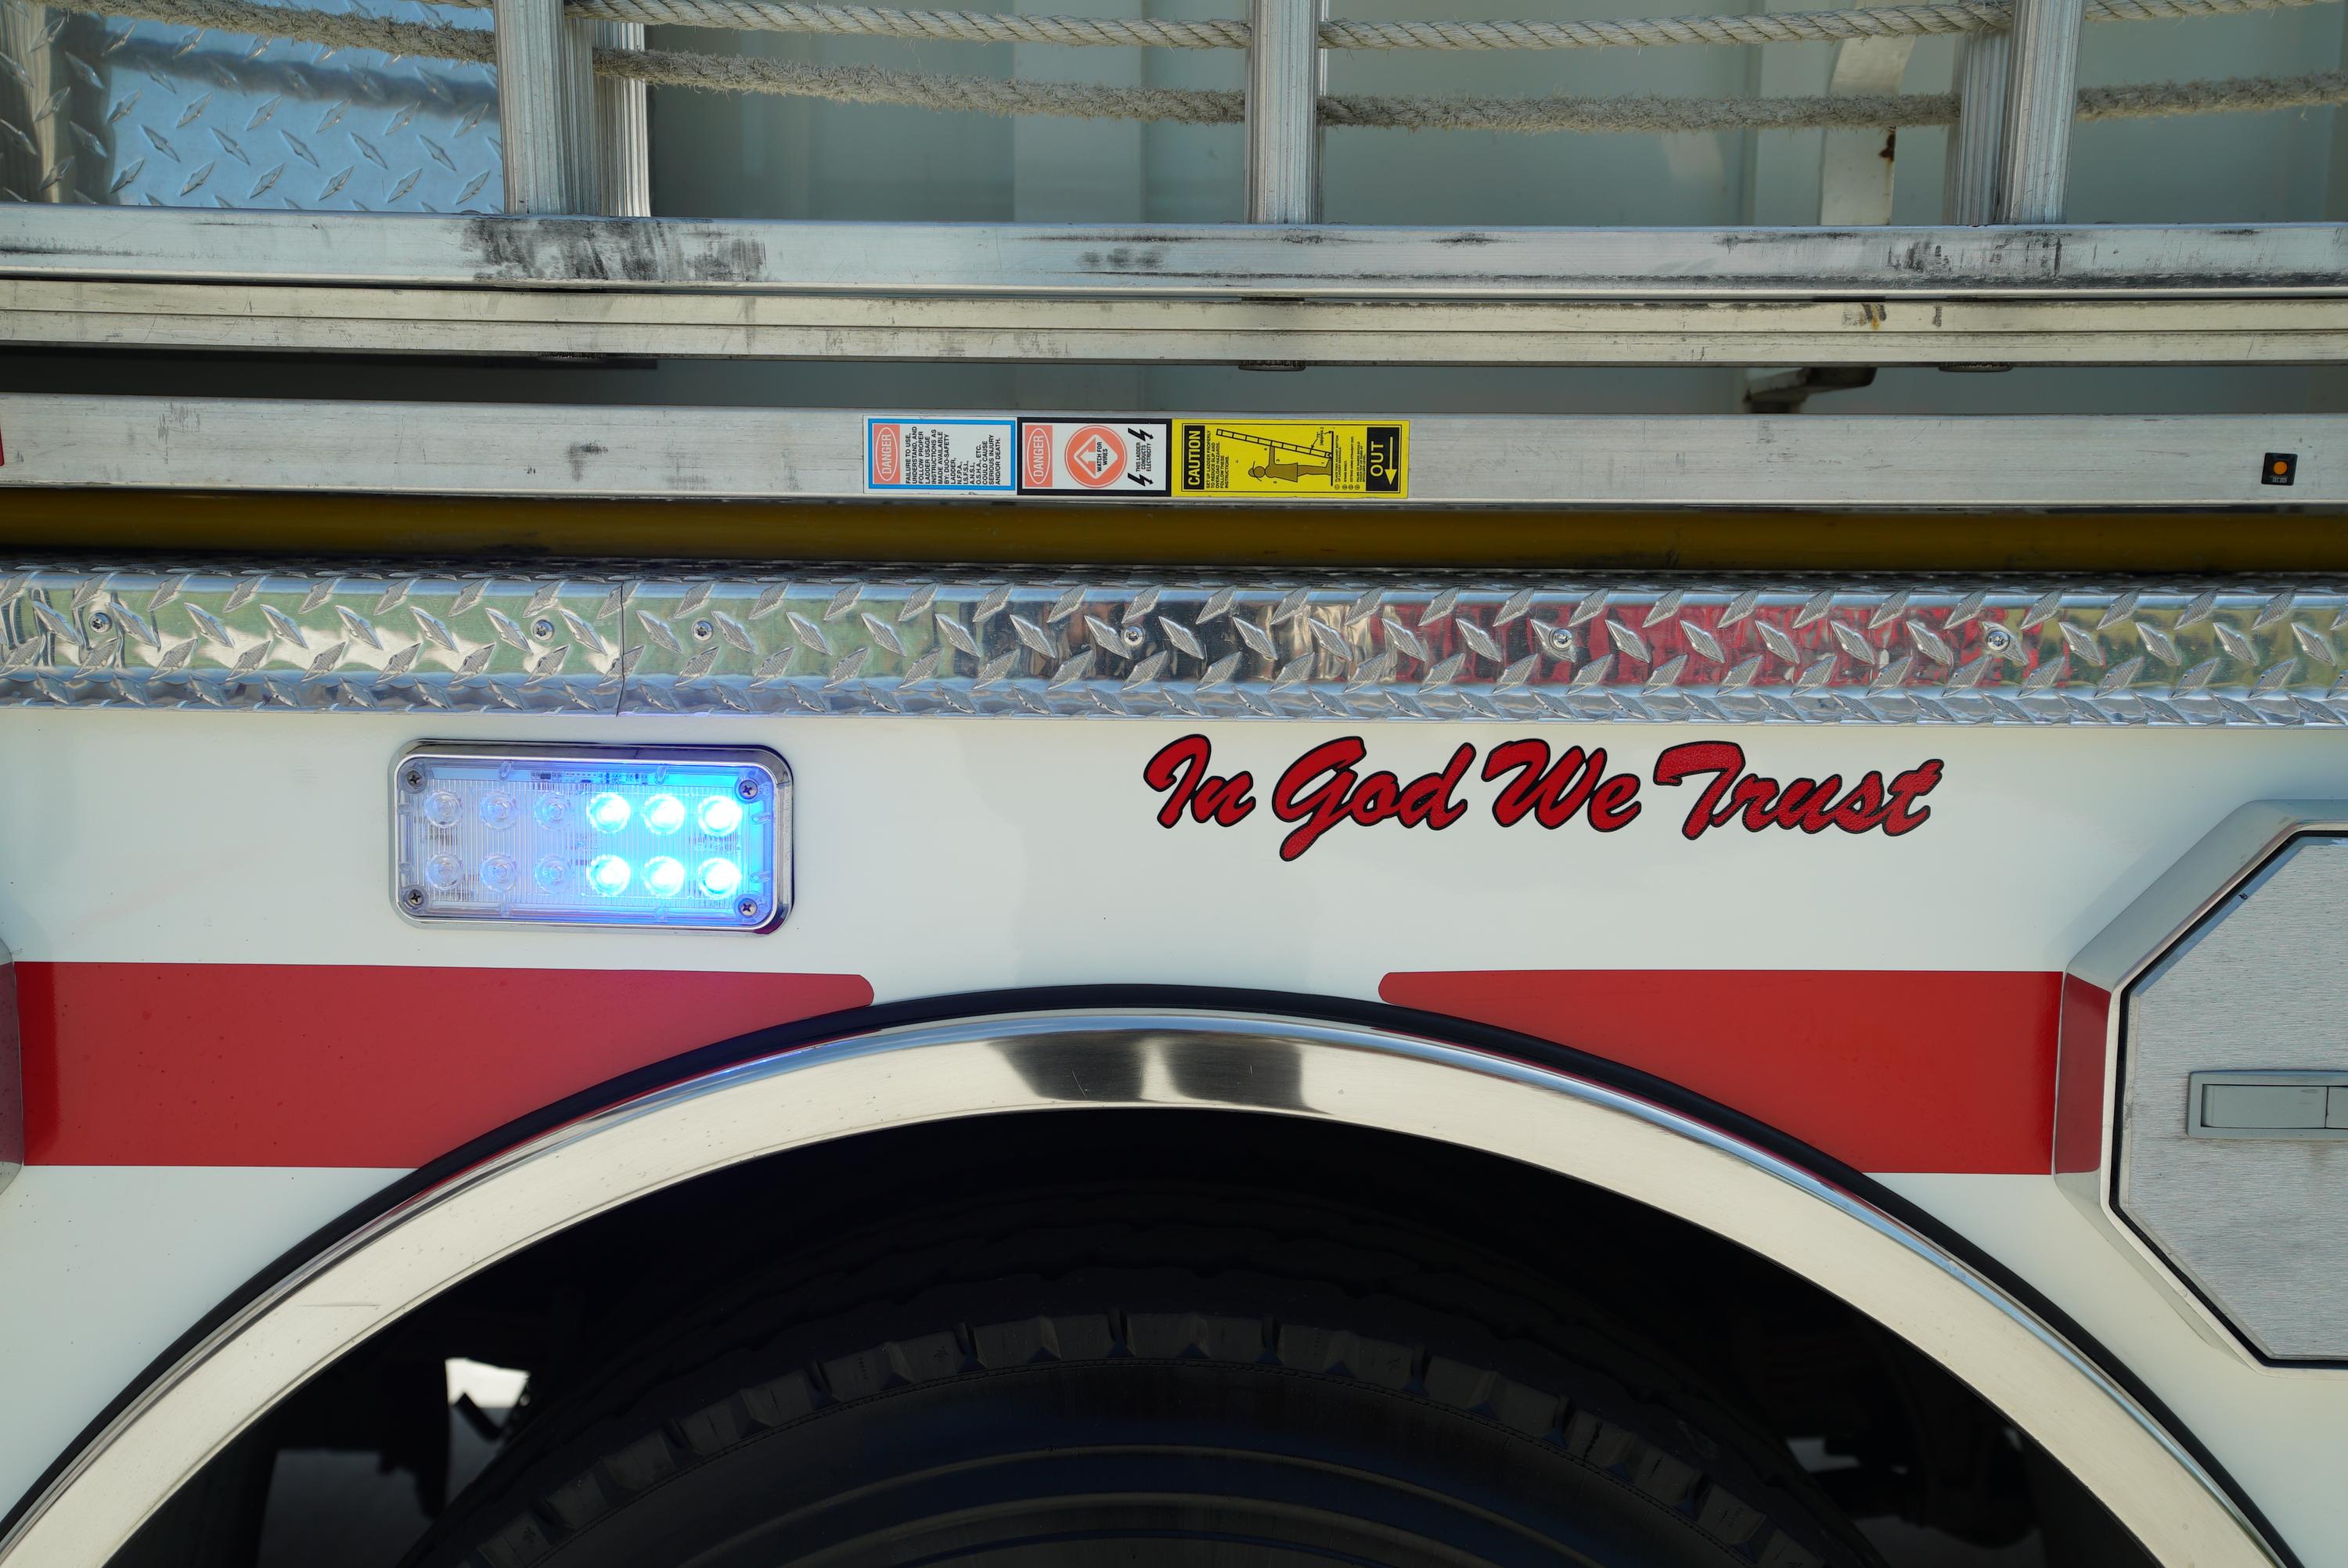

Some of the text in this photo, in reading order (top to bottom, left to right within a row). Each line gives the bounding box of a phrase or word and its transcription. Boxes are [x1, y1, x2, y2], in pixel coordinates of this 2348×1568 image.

[881, 434, 891, 474] DANGER
[1033, 436, 1044, 477] DANGER
[1188, 431, 1200, 485] CAUTION
[1370, 441, 1384, 477] OUT
[1143, 734, 1944, 861] In God We Trust
